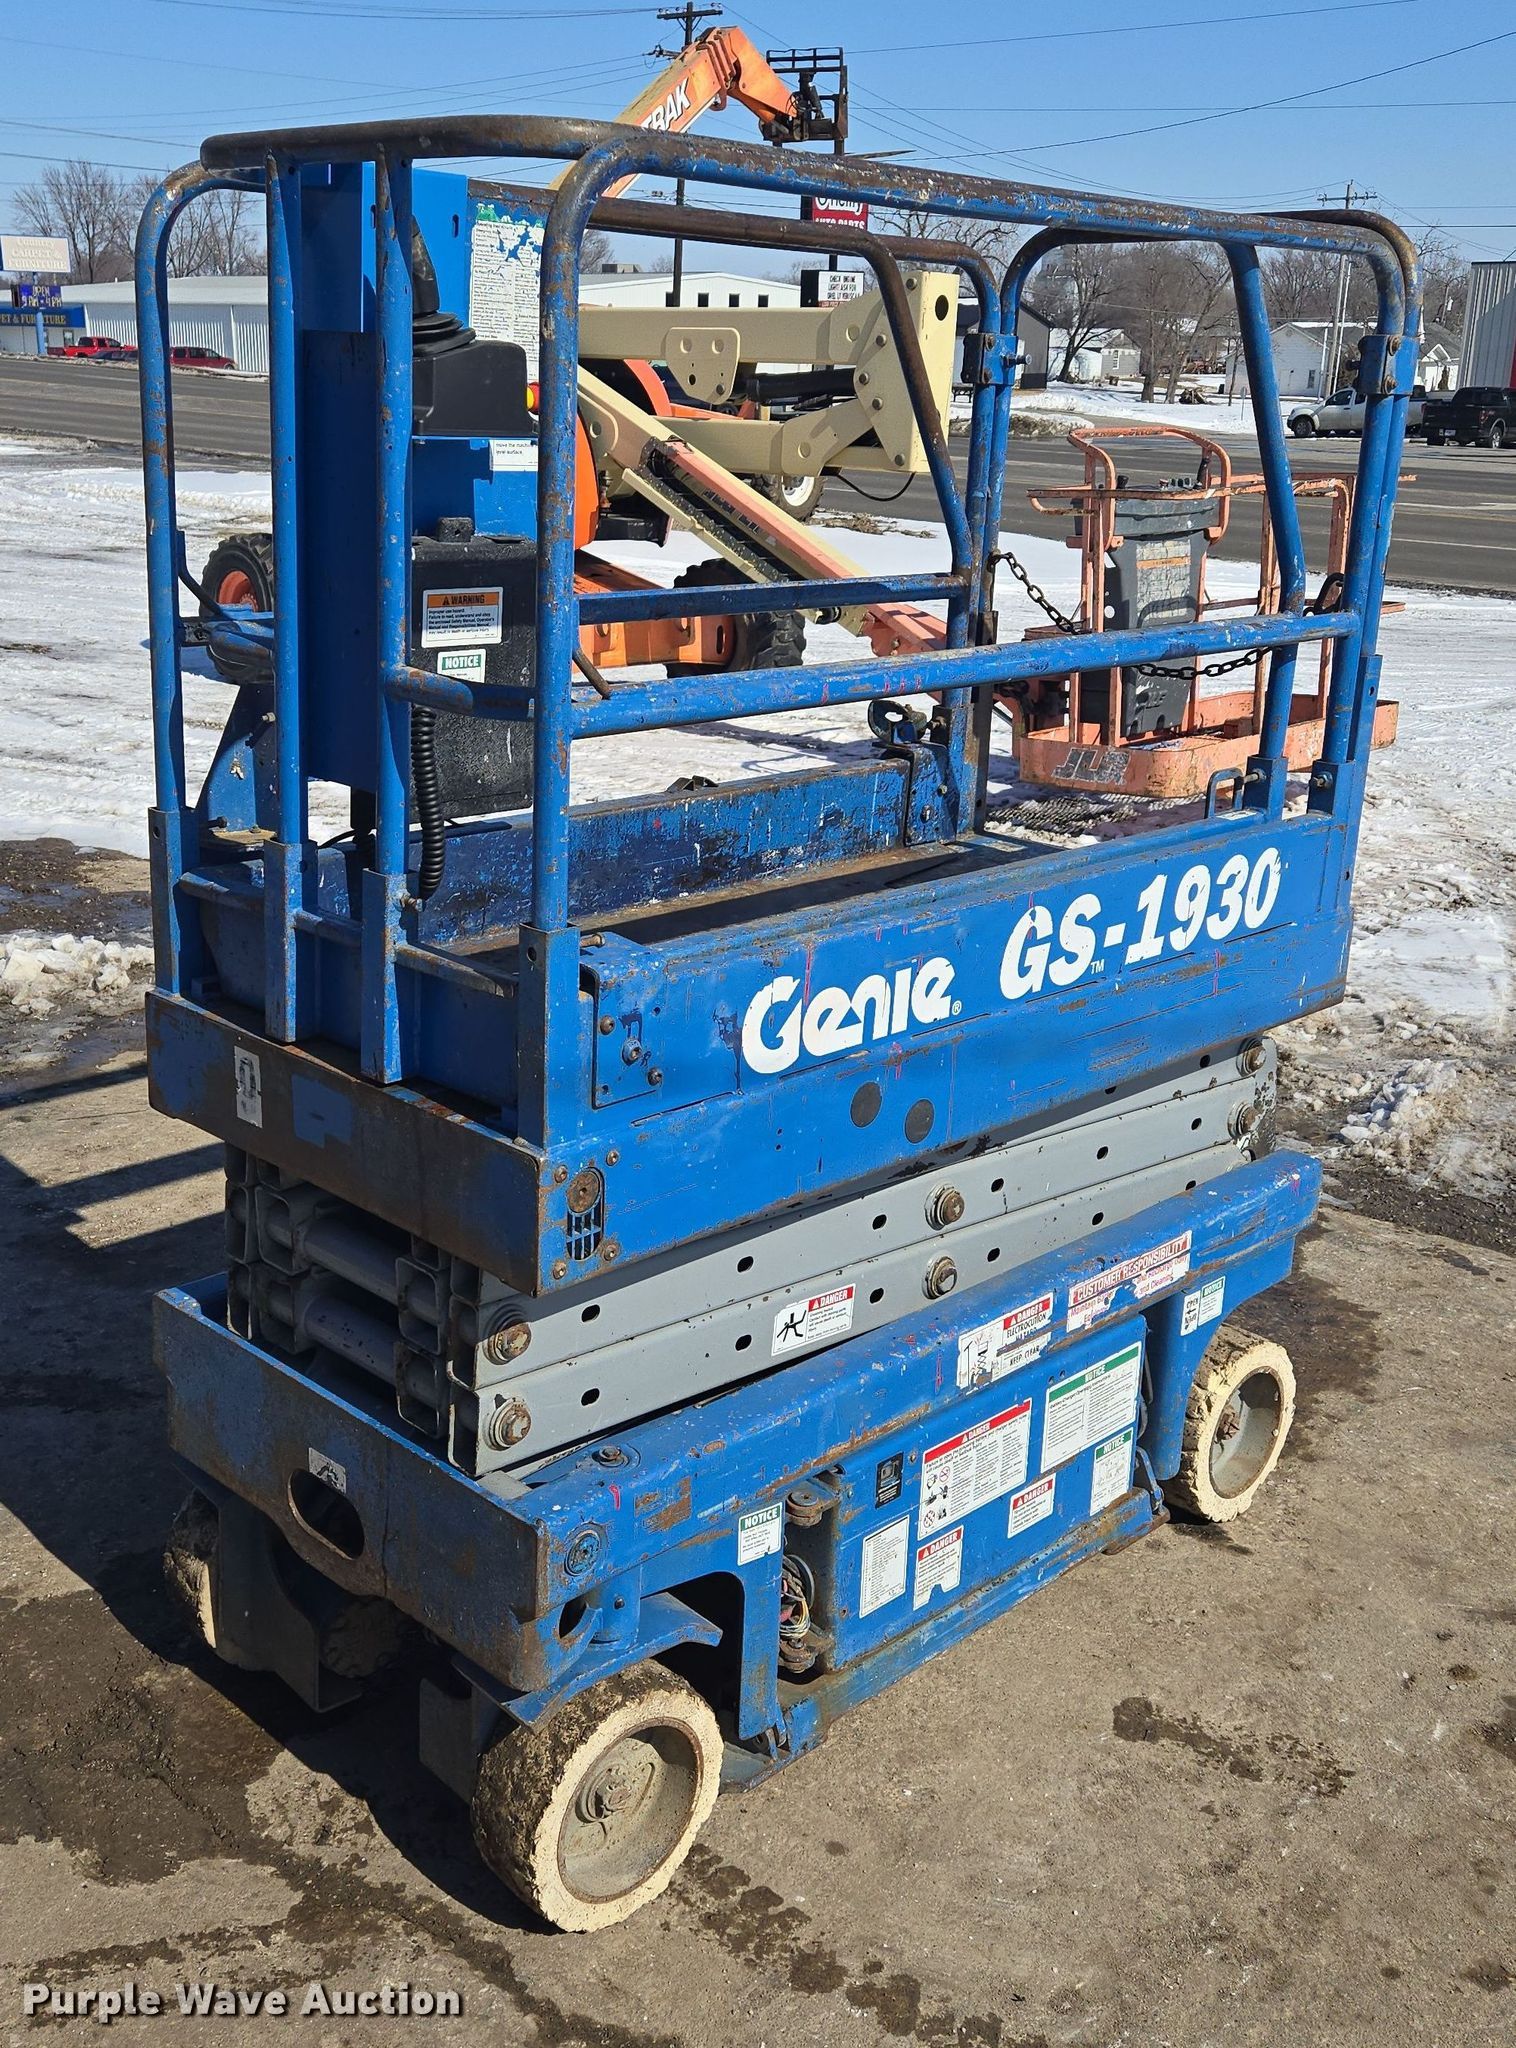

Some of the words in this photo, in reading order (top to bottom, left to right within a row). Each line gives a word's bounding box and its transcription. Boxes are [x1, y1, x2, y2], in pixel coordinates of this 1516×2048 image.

[33, 286, 50, 296] OPEN
[0, 314, 10, 323] ET
[21, 314, 66, 324] FURTURE
[452, 595, 484, 604] WARNING
[446, 656, 478, 668] NOTICE
[1000, 847, 1283, 1000] GS-1930
[1077, 1271, 1121, 1299] CUSTOMER
[1122, 1241, 1184, 1279] RESPONSIBILITY
[821, 1289, 848, 1305] DANGER
[1018, 1304, 1043, 1321] DANGER
[1007, 1313, 1046, 1339] ELECTROCUTION
[1085, 1365, 1105, 1383] NOTICE
[969, 1423, 990, 1439] DANGER
[1104, 1435, 1125, 1455] NOTICE
[1023, 1483, 1048, 1503] DANGER
[745, 1508, 777, 1528] NOTICE
[930, 1532, 957, 1554] DANGER
